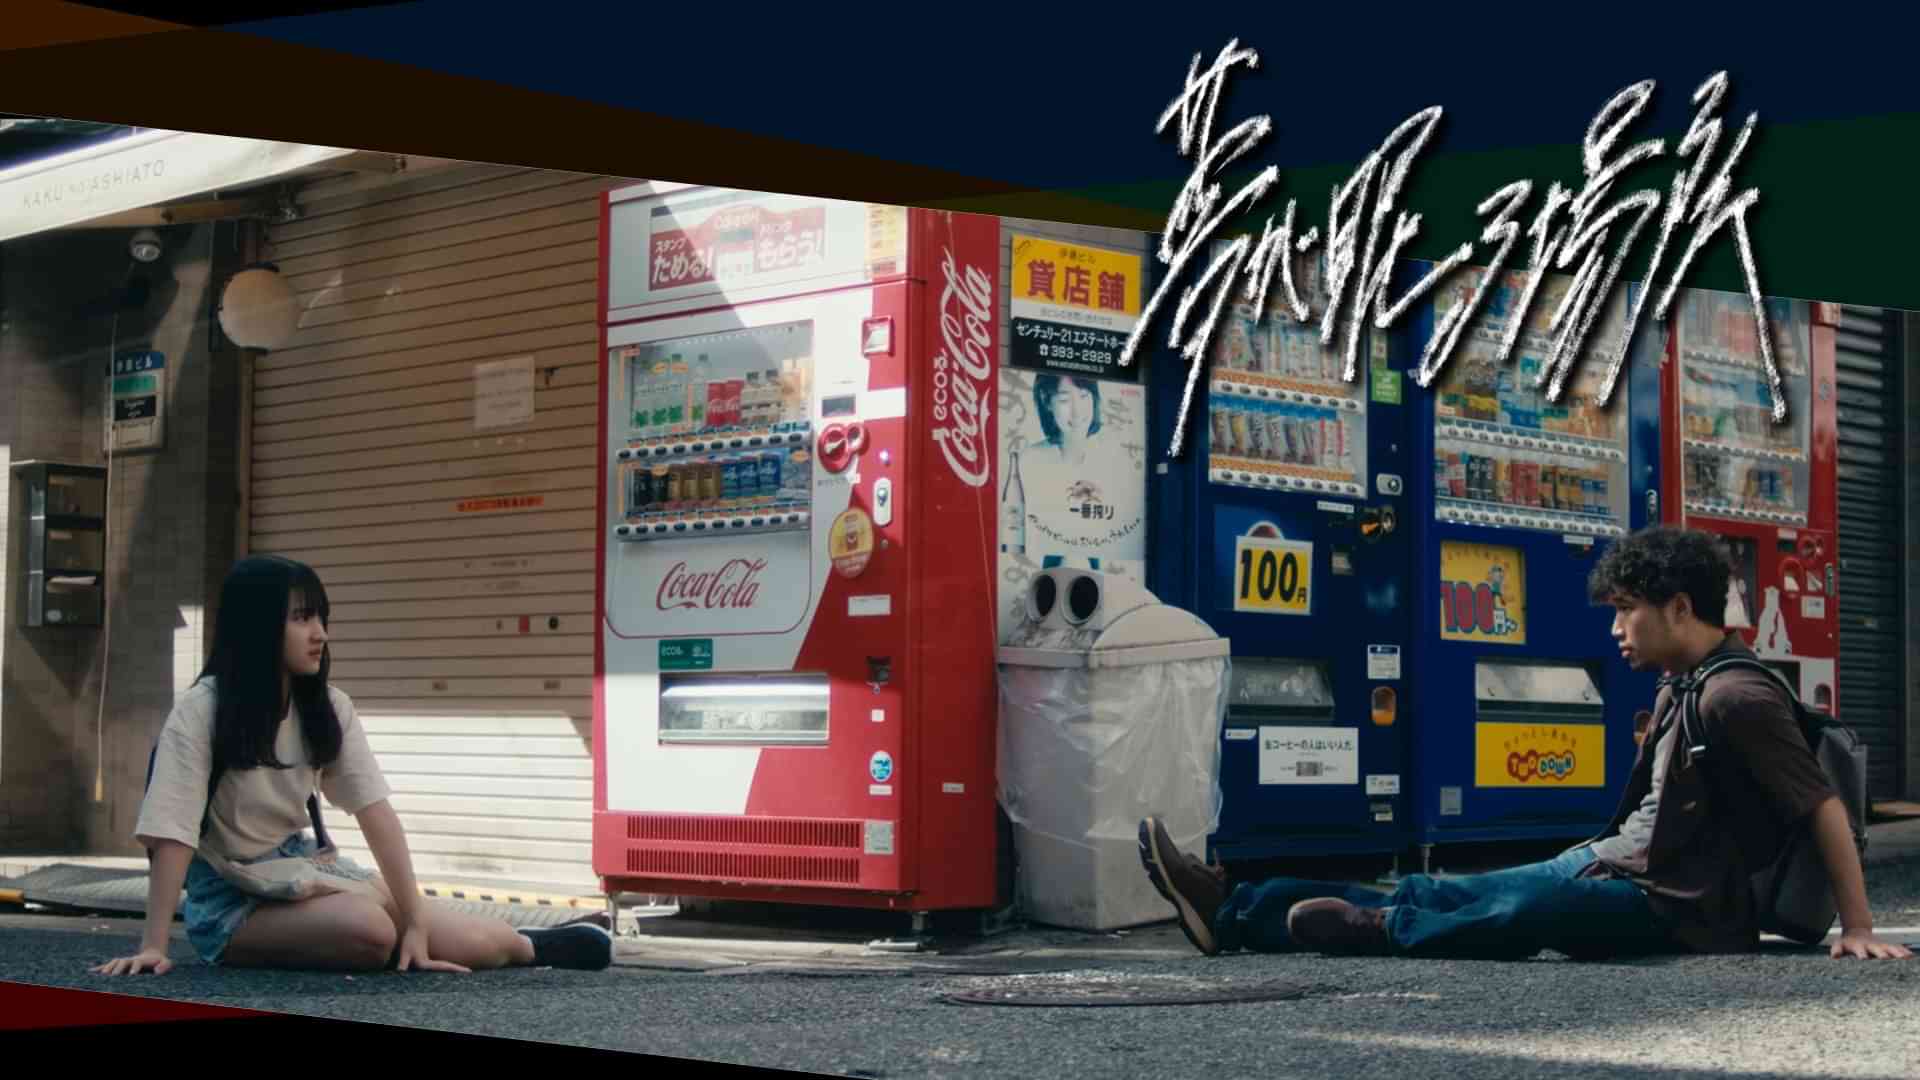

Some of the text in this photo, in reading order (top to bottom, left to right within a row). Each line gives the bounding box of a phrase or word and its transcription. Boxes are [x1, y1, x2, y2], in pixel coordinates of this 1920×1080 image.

[655, 238, 687, 253] スタンプ
[1027, 259, 1125, 311] 貸店舗
[1016, 321, 1128, 350] センチュリー21エステートホー
[933, 246, 992, 487] Coca-Cola
[1069, 504, 1114, 521] 一番搾り
[656, 558, 768, 612] Coca-Cola
